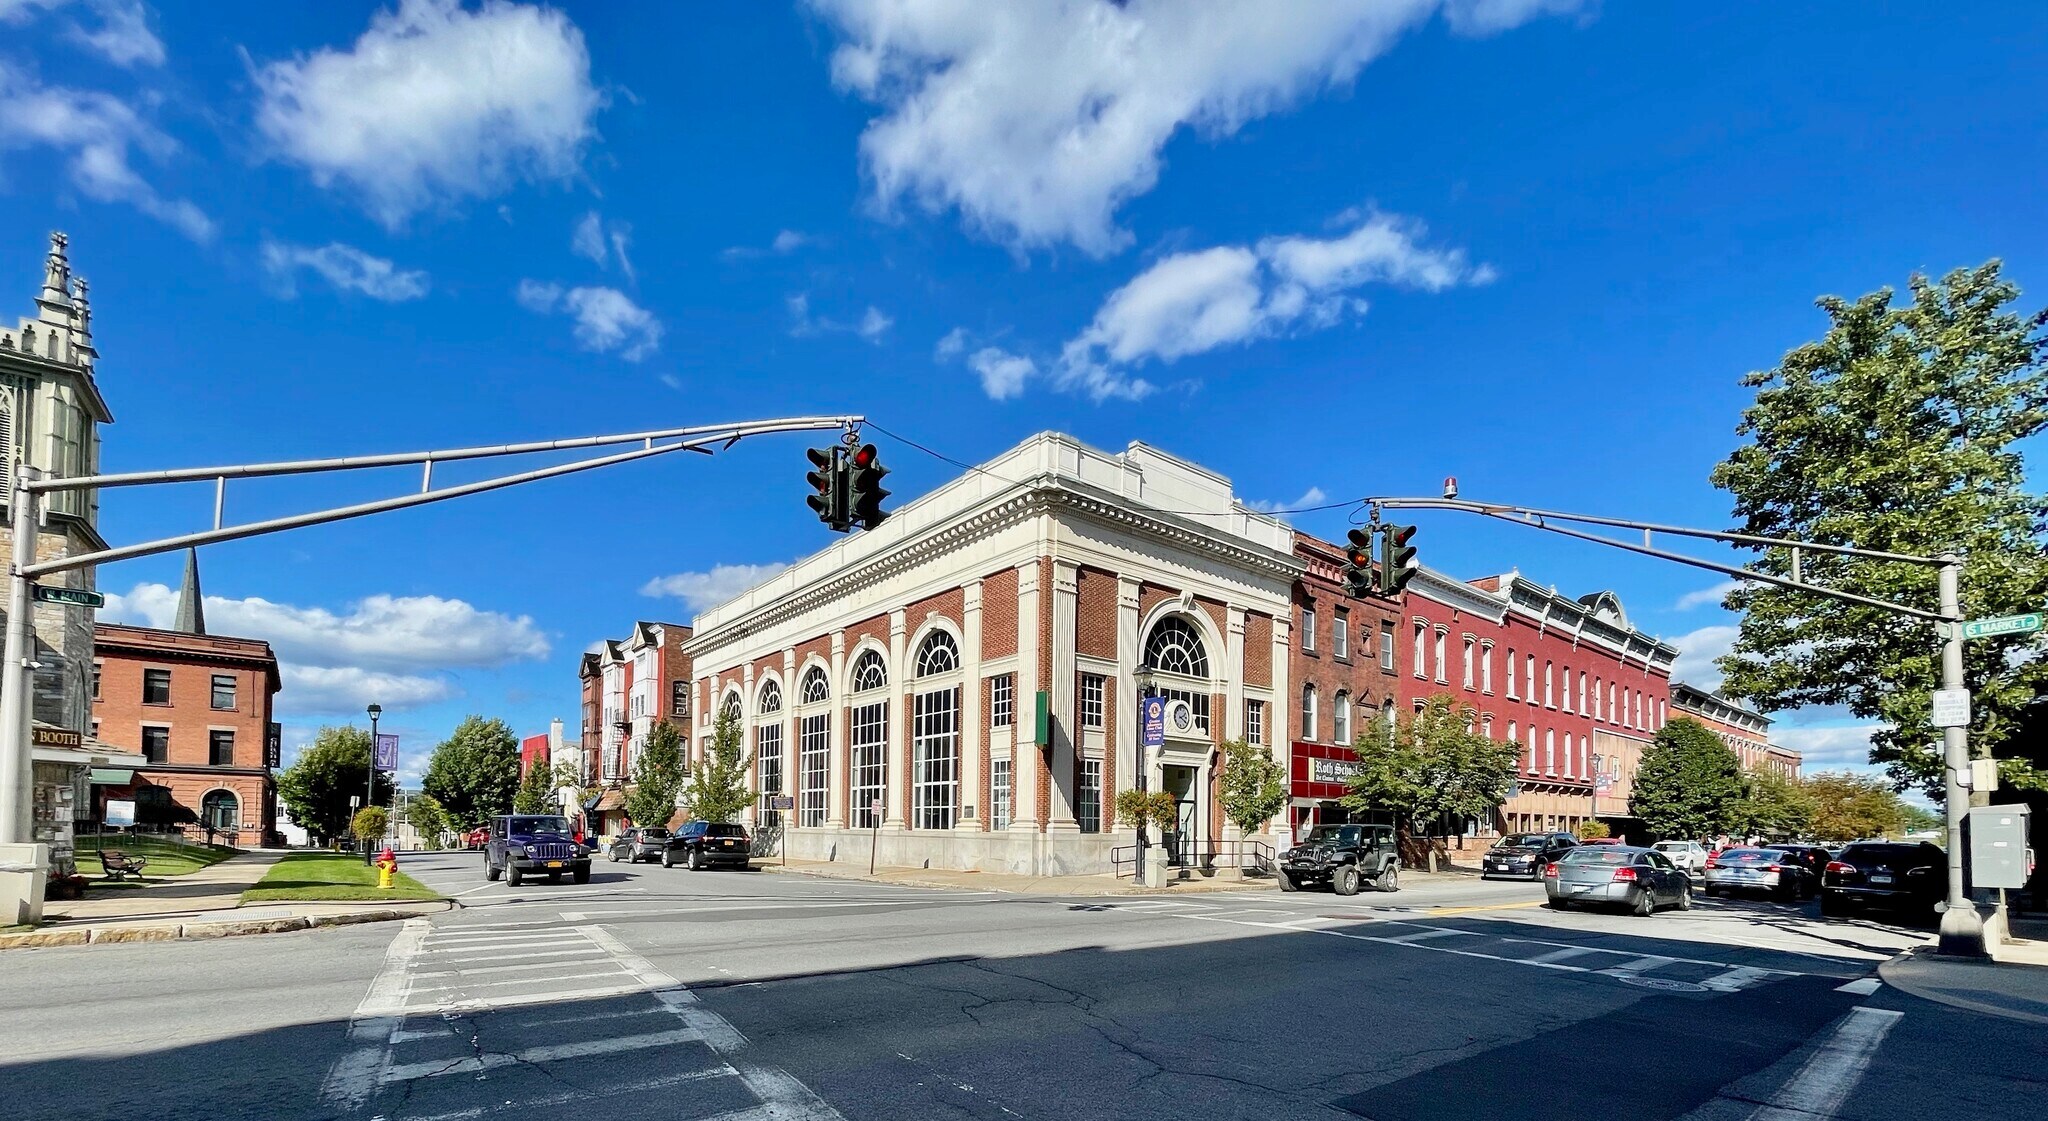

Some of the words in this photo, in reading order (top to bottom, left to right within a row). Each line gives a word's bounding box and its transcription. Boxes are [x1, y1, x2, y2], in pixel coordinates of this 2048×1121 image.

[60, 591, 89, 602] MAIN
[1980, 619, 2026, 633] MARKET
[40, 731, 79, 745] BOOTH
[1315, 760, 1333, 776] Roth
